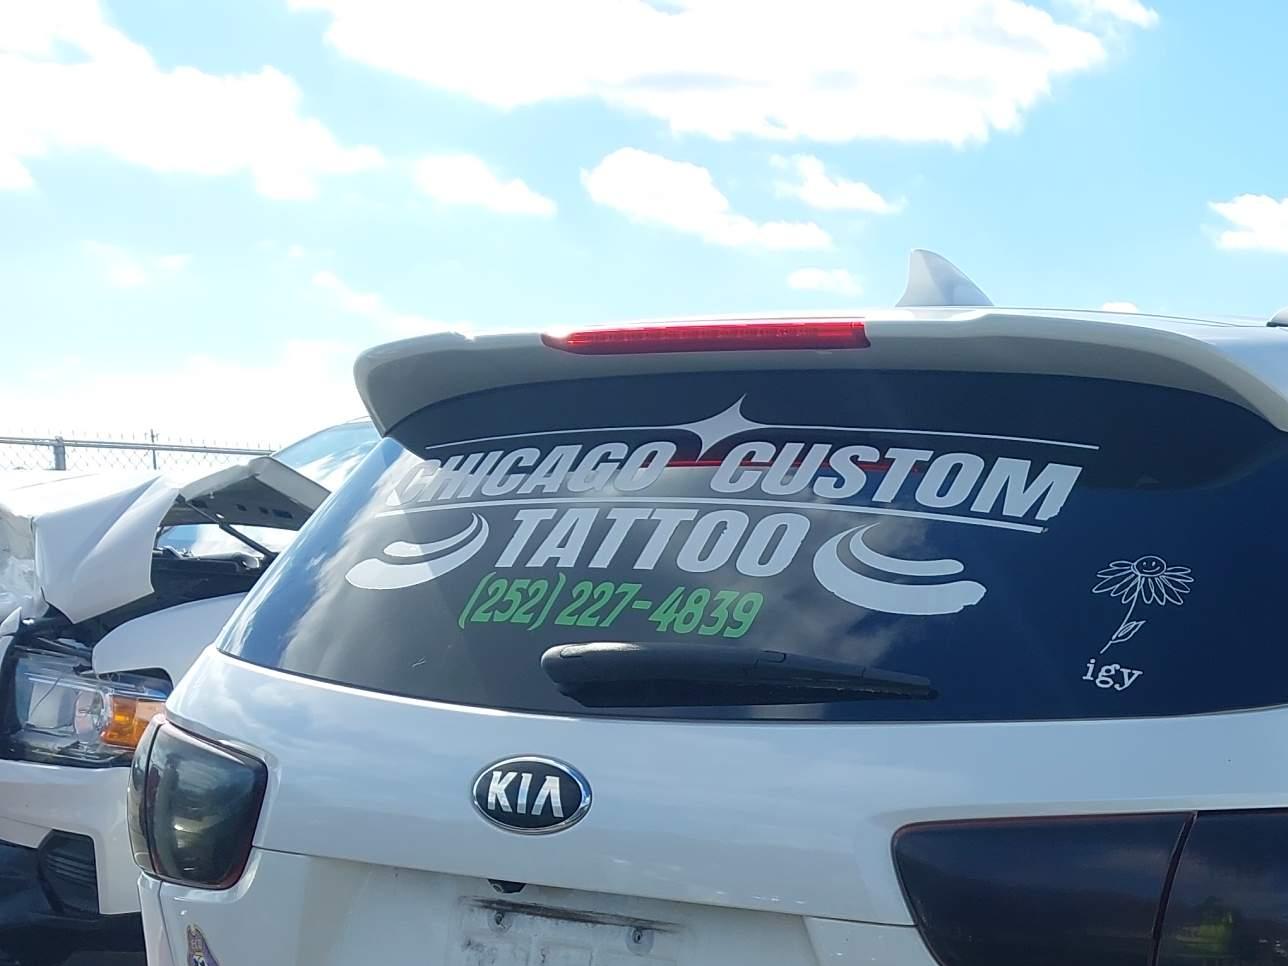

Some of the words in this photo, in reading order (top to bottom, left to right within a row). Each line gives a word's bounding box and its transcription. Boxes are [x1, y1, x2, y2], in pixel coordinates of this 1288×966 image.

[386, 441, 677, 505] CHICAGO
[710, 440, 1083, 521] CUSTOM
[495, 507, 811, 578] TATTOO
[458, 572, 566, 631] (252)
[555, 581, 764, 638] 227-4839
[1082, 658, 1143, 691] igy
[486, 771, 564, 818] KIA
